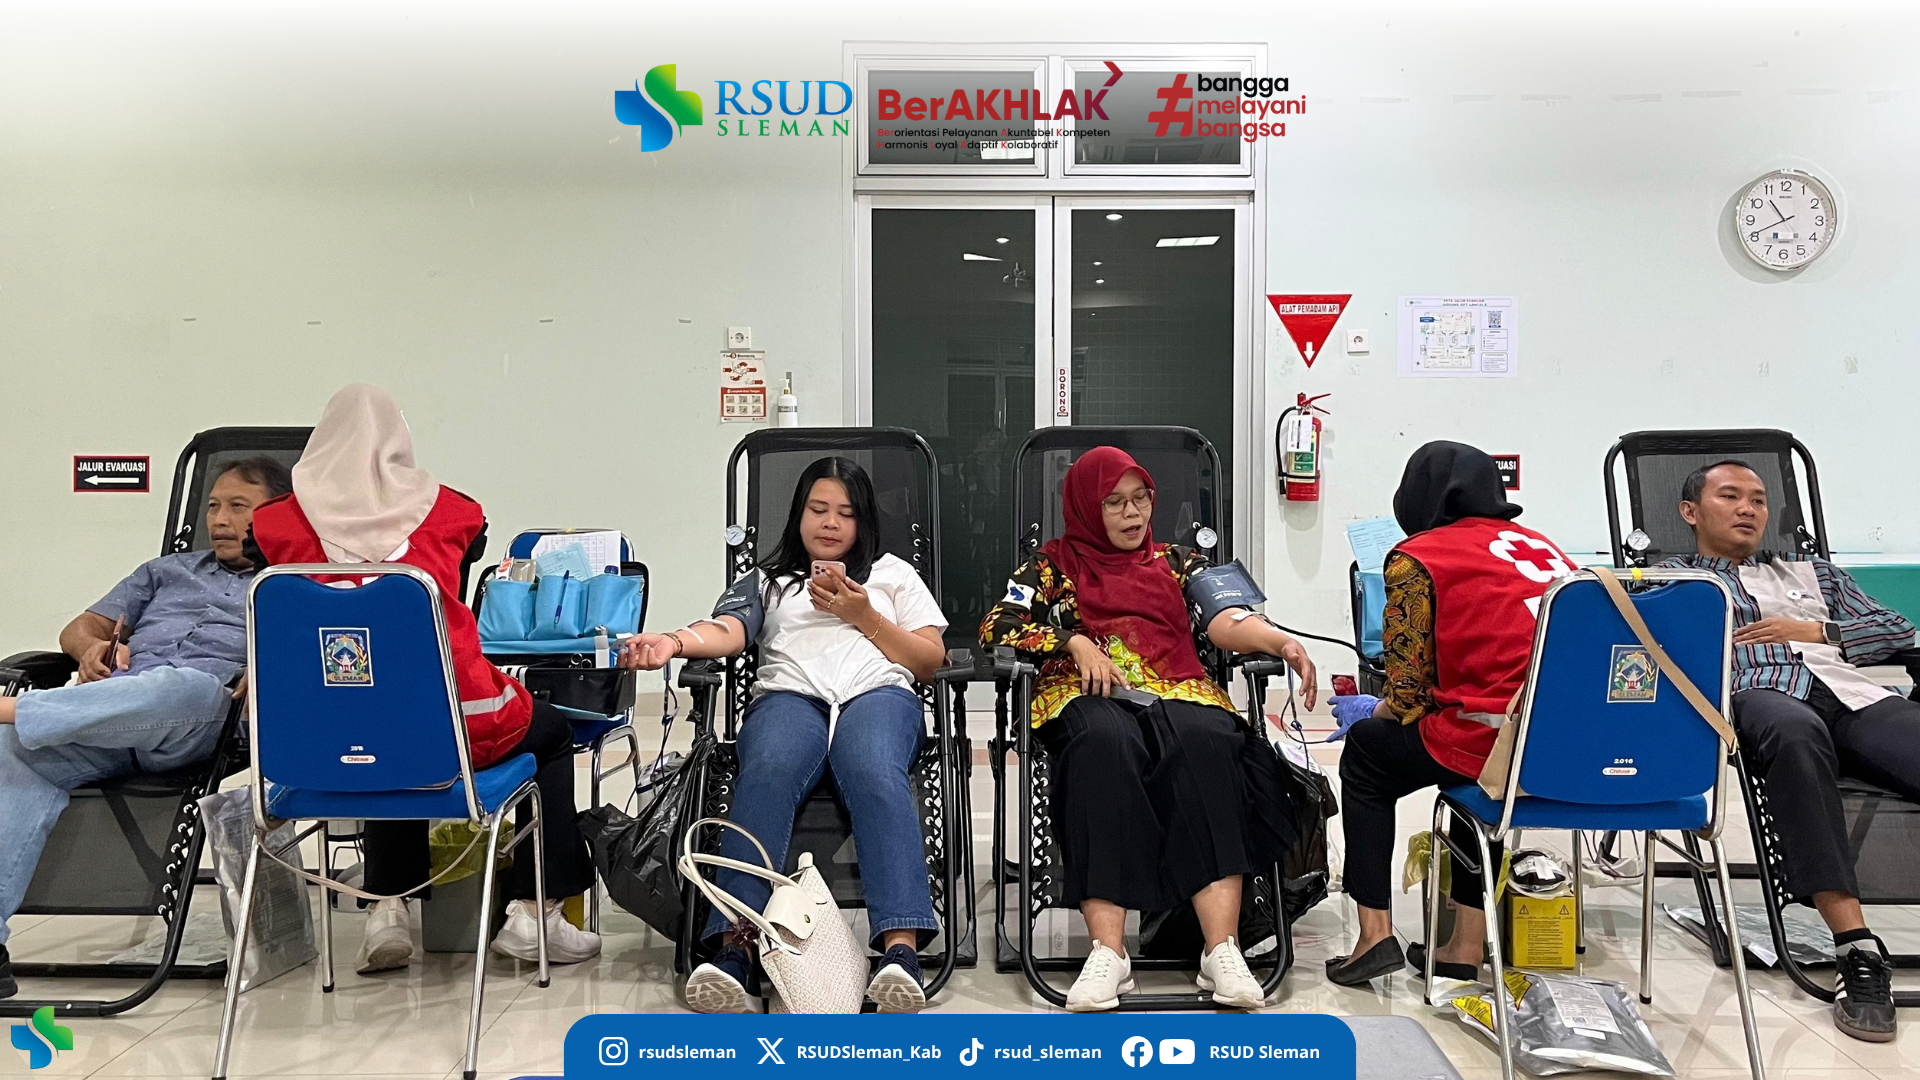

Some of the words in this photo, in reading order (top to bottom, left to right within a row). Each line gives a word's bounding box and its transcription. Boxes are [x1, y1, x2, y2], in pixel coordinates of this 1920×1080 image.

[1764, 184, 1773, 195] 11
[1780, 180, 1792, 192] 12
[1801, 184, 1805, 196] 1
[1750, 198, 1763, 209] 10
[1810, 198, 1819, 209] 2
[1745, 215, 1755, 226] 9
[1815, 215, 1824, 226] 3
[1809, 232, 1818, 243] 4
[1764, 245, 1773, 255] 7
[1778, 249, 1788, 260] 6
[1796, 245, 1806, 256] 5
[1281, 304, 1297, 313] ALAT
[1297, 304, 1327, 313] PEMADAM
[1328, 304, 1339, 313] API
[1058, 368, 1067, 412] DORONG
[77, 461, 104, 472] JALUR
[105, 461, 146, 472] EVAKUASI
